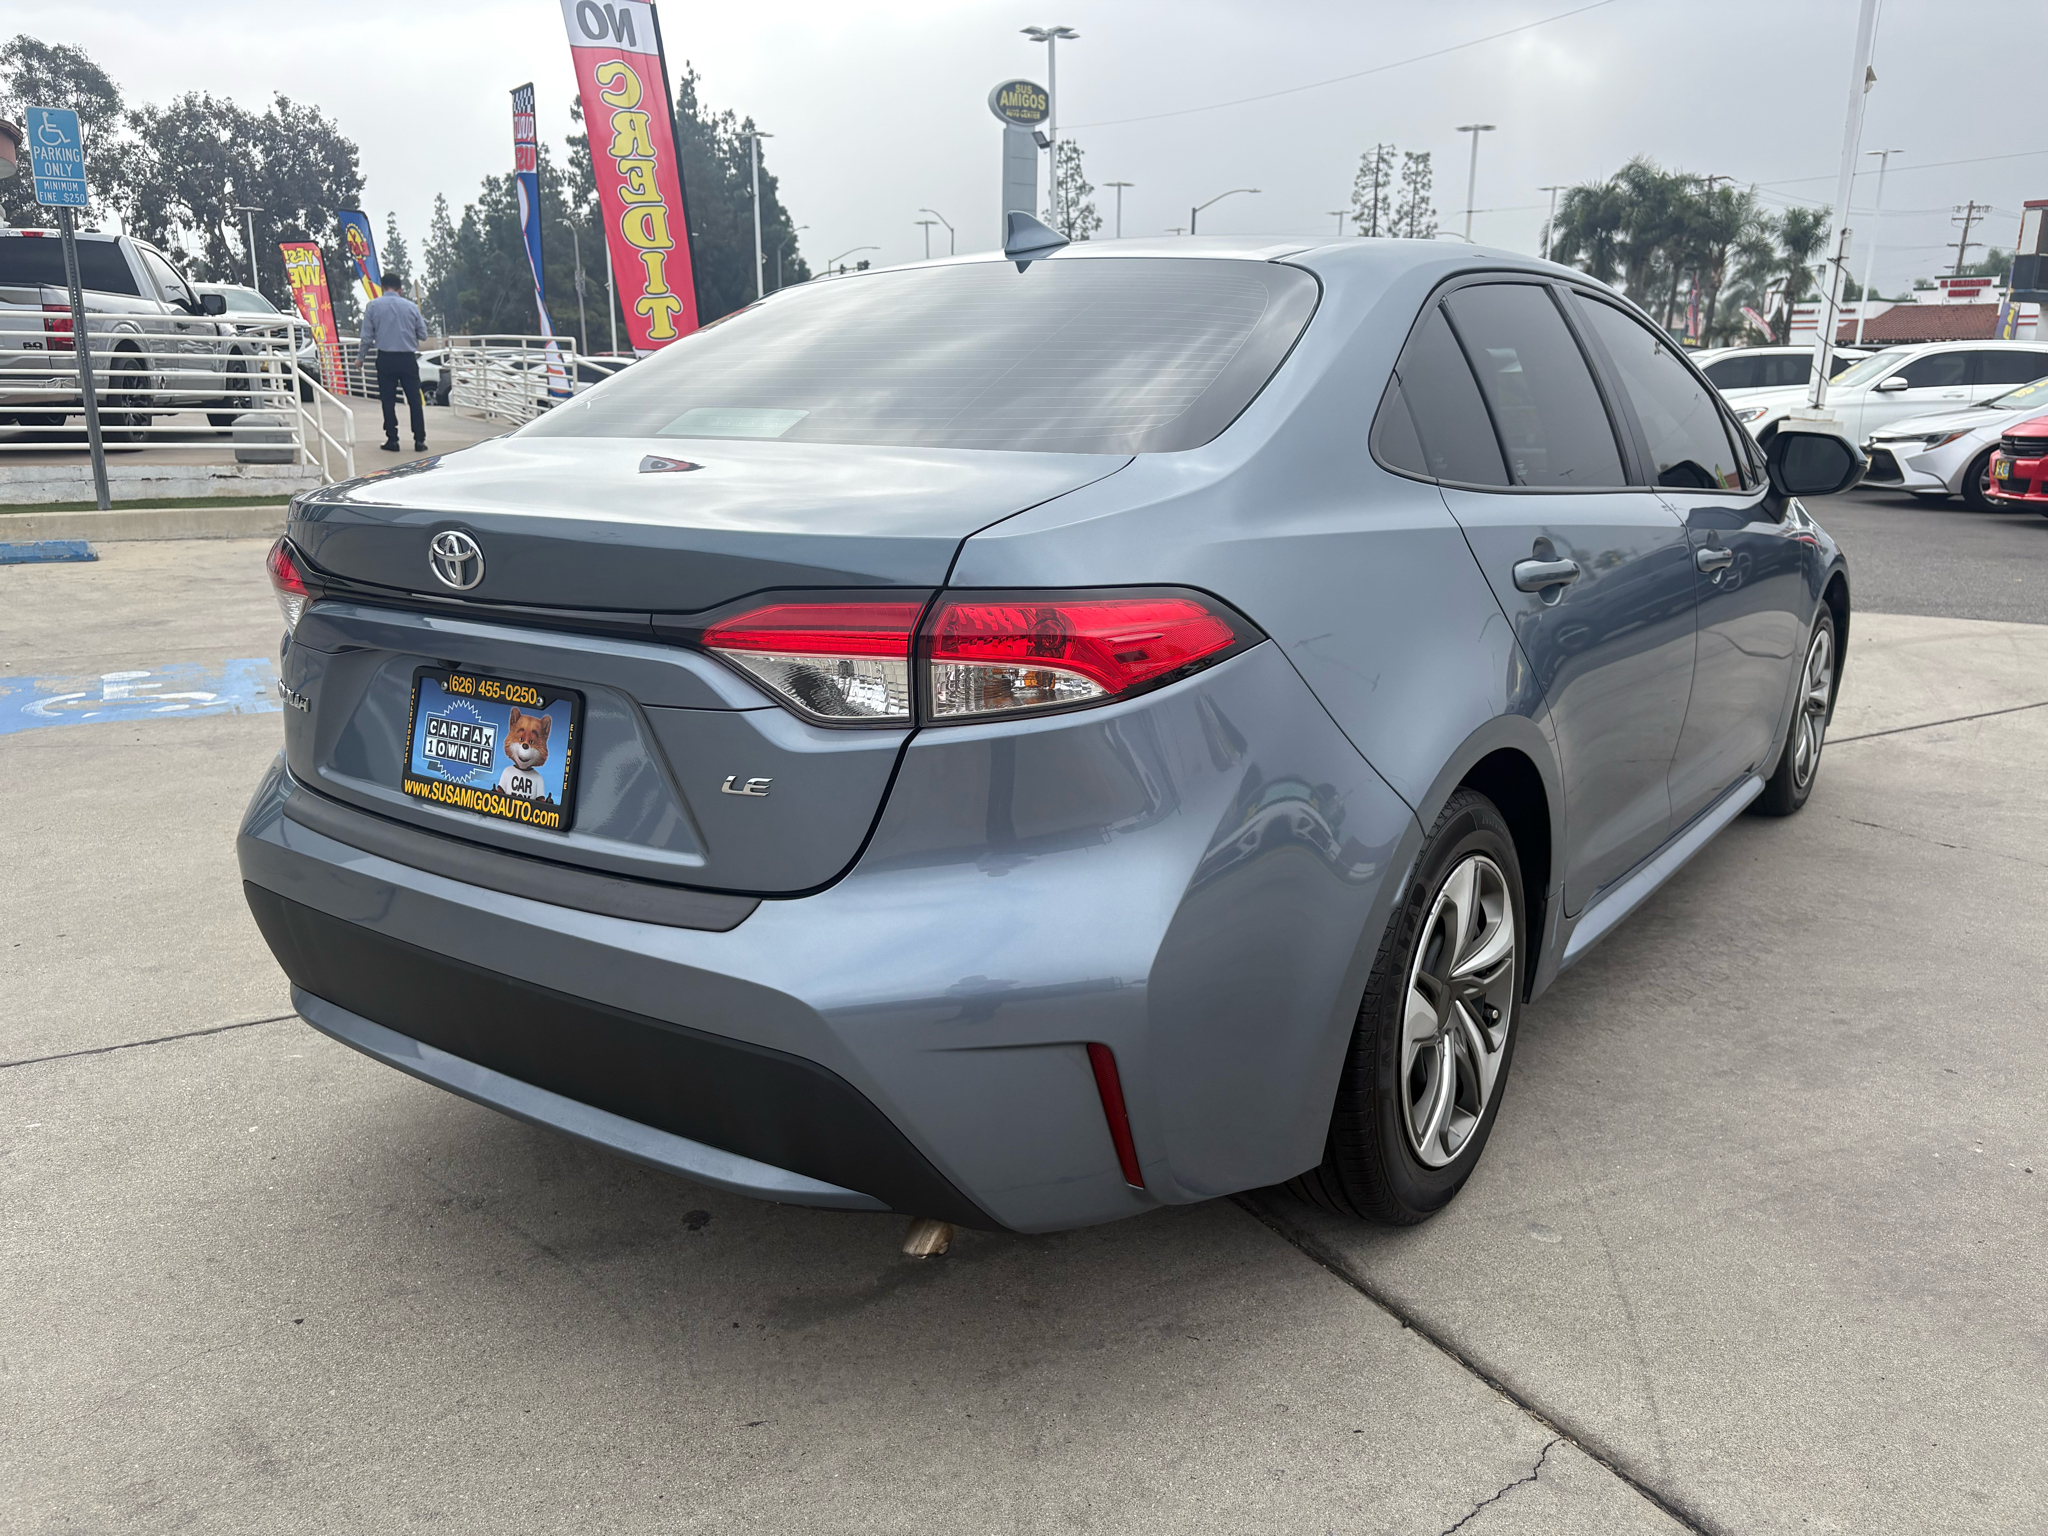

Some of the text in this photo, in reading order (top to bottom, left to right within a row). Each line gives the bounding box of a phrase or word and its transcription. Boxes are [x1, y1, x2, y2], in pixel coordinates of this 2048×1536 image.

[1015, 84, 1033, 95] SUS
[1000, 90, 1047, 111] AMIGOS
[34, 146, 80, 162] PARKING
[44, 162, 73, 177] ONLY
[43, 180, 79, 192] MINIMUM
[39, 191, 85, 203] FINE $250
[449, 674, 537, 705] (626) 455-0250
[429, 720, 492, 747] CARFAX
[511, 775, 533, 794] CAR
[721, 775, 773, 797] LE
[403, 778, 560, 829] www.SUSAMIGOSAUTO.com
